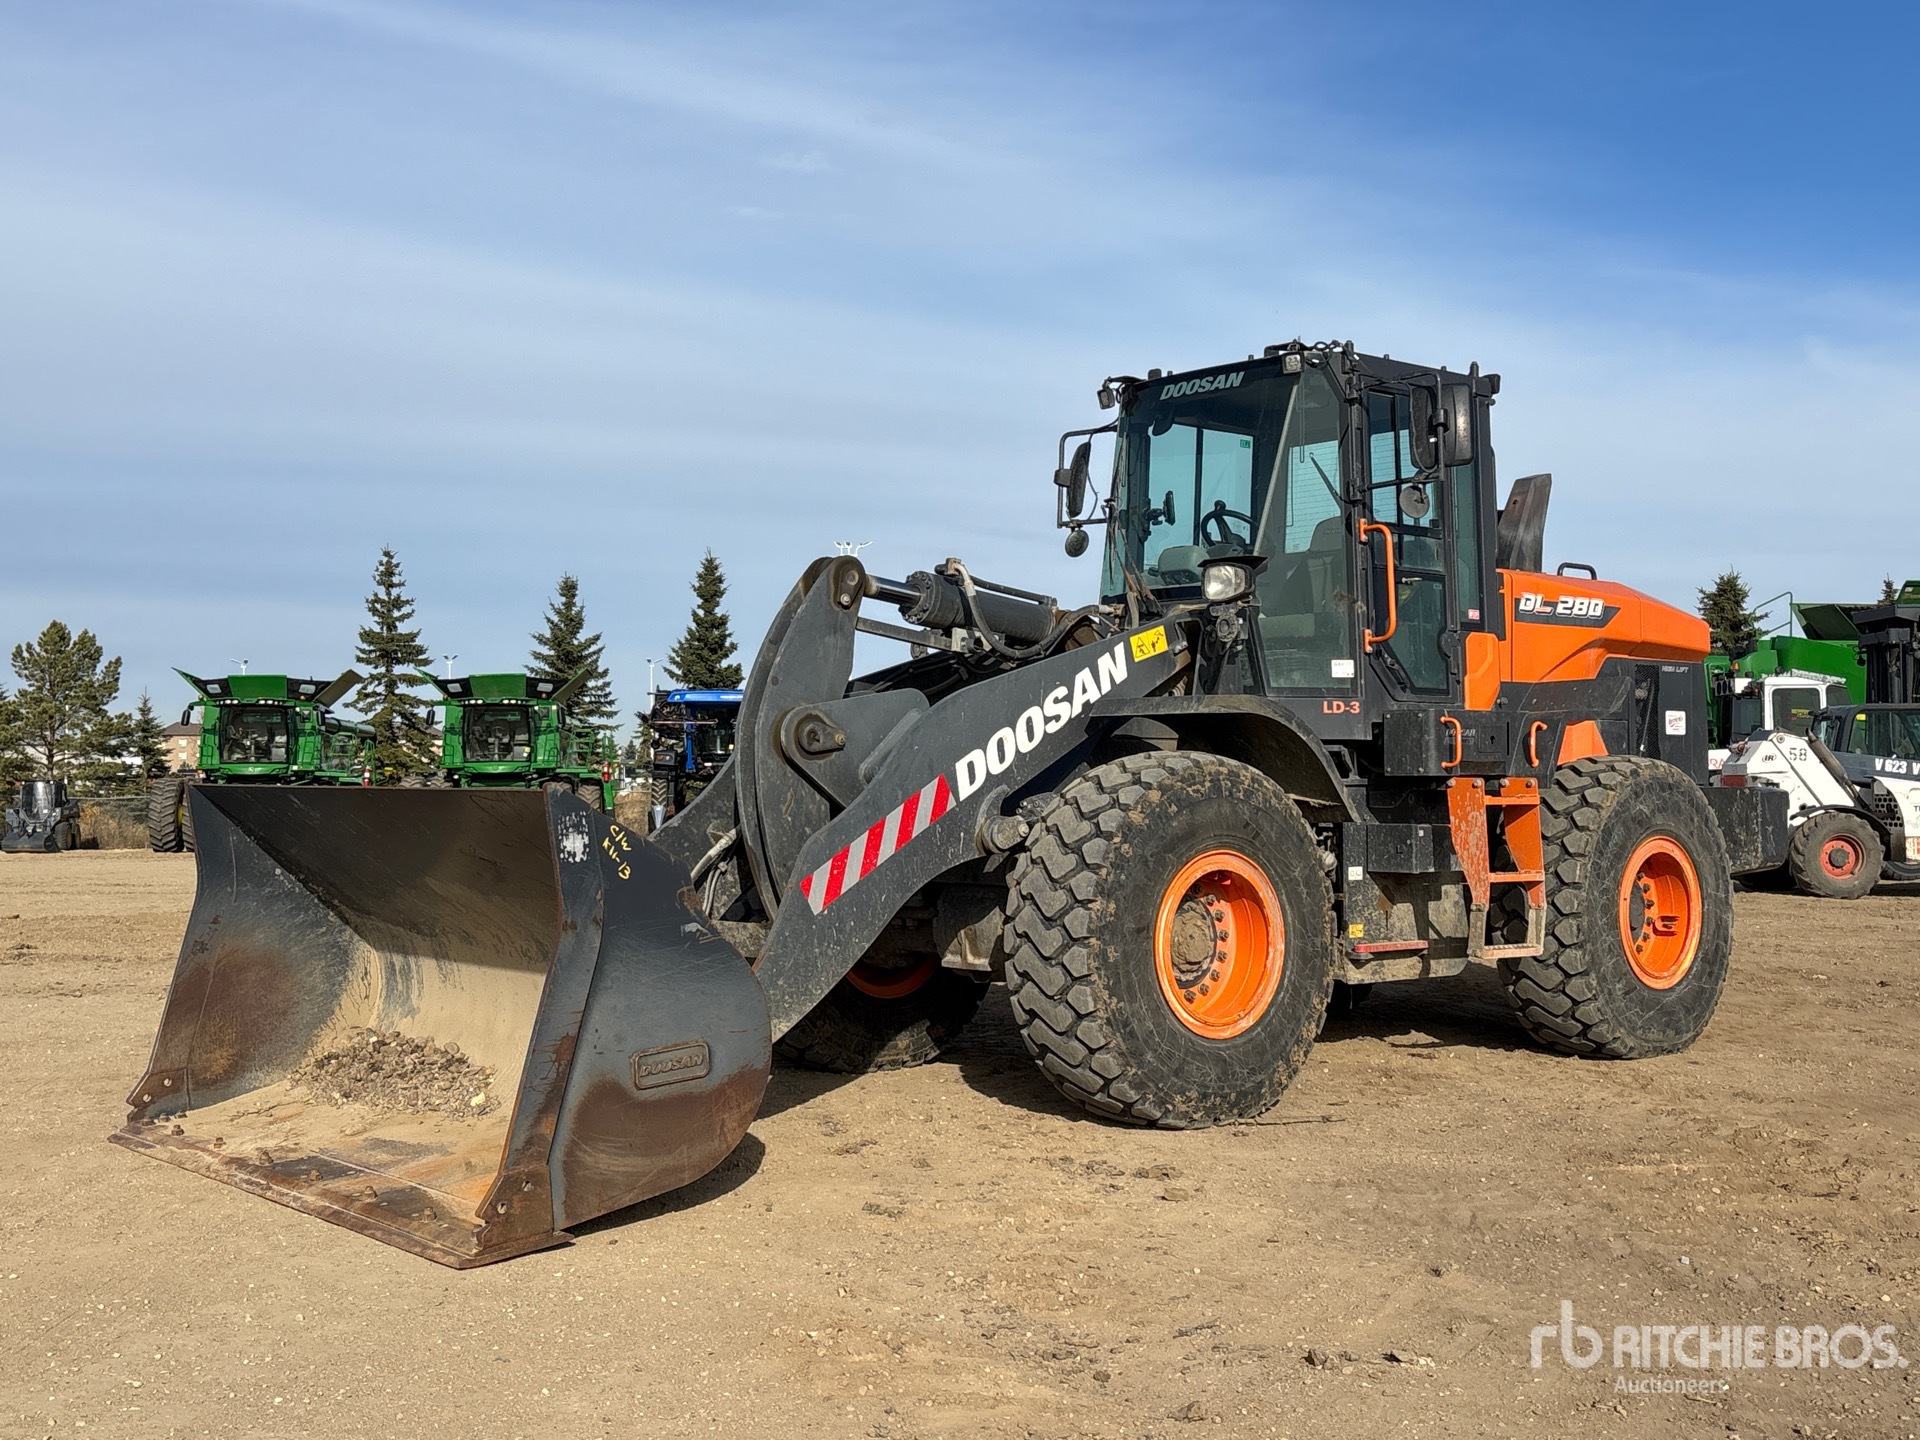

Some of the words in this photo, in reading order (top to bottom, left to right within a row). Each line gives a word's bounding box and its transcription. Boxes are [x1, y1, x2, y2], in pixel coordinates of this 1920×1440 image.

[1160, 371, 1246, 401] DOOSAN
[1519, 592, 1553, 616] DL
[1556, 595, 1604, 619] 280
[1323, 700, 1360, 714] LD-3
[955, 641, 1128, 802] DOOSAN
[1789, 747, 1807, 761] 58
[1874, 758, 1884, 771] V
[1884, 759, 1907, 774] 623
[640, 1054, 704, 1078] DOOSAN
